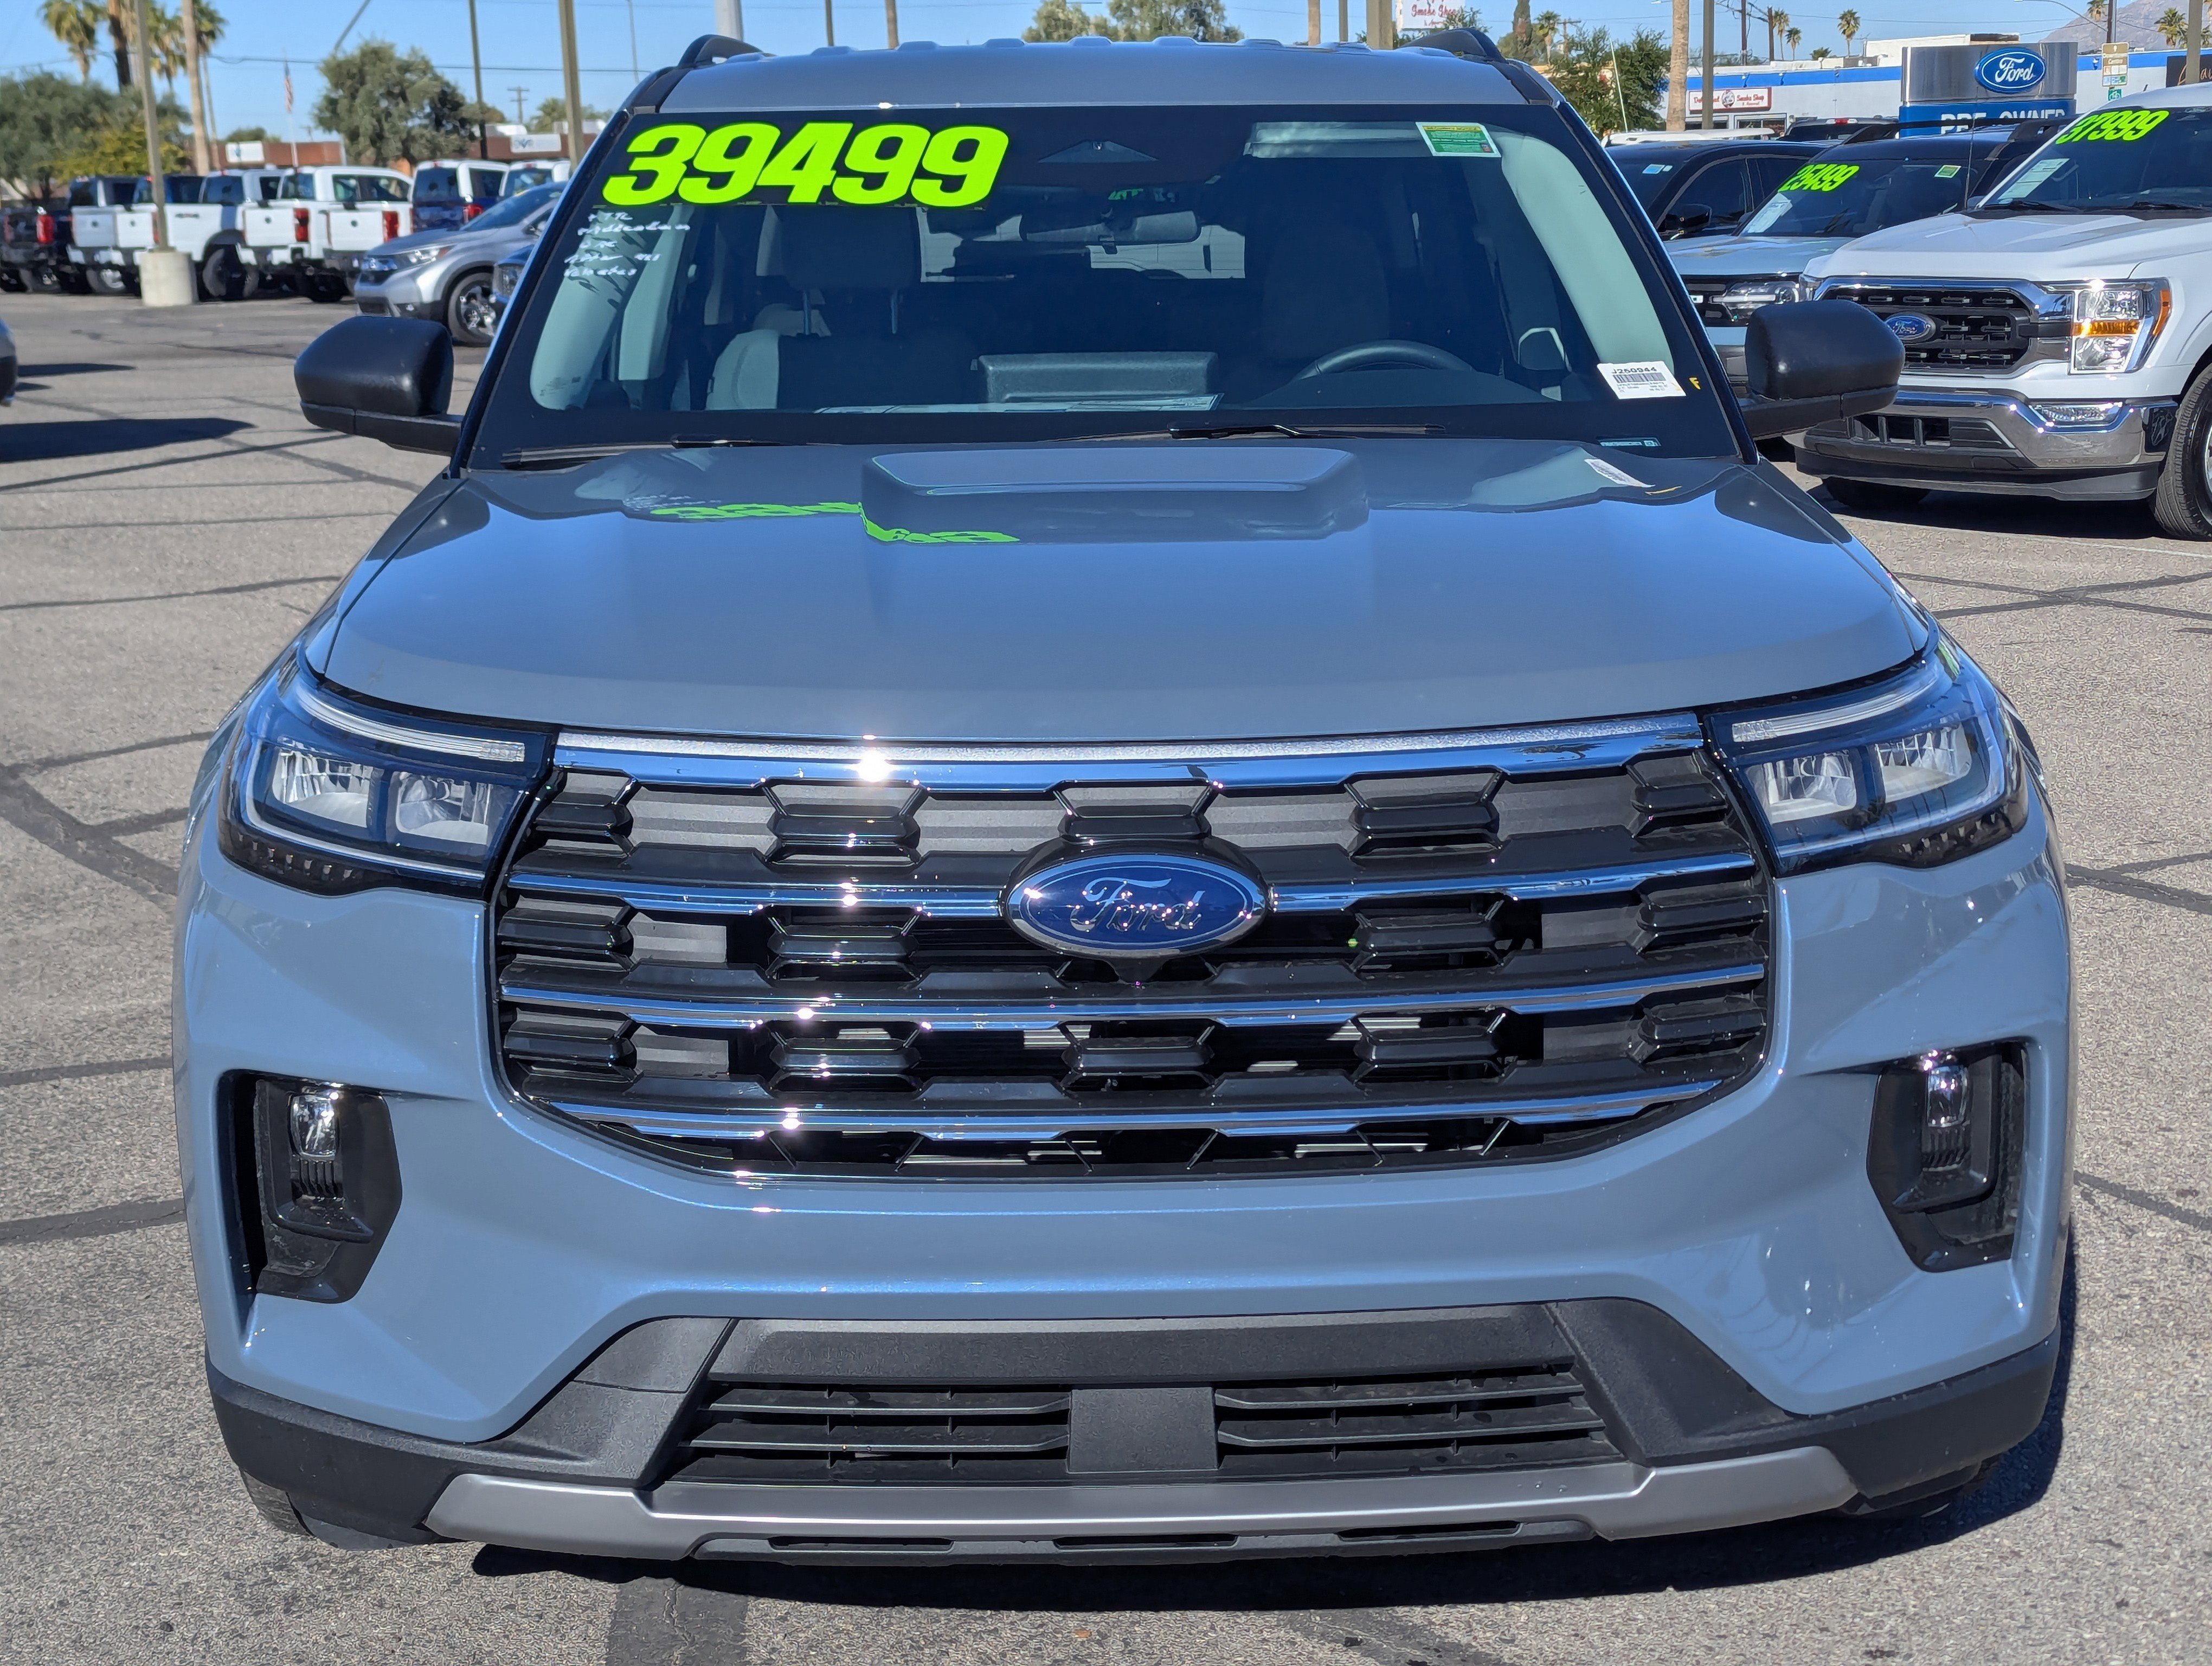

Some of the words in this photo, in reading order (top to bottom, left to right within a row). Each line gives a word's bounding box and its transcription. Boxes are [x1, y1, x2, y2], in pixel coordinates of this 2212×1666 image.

[1995, 57, 2036, 82] Ford
[2055, 110, 2170, 144] 37999
[602, 122, 1009, 207] 39499
[1778, 164, 1860, 193] 25499
[1070, 876, 1205, 932] Ford
